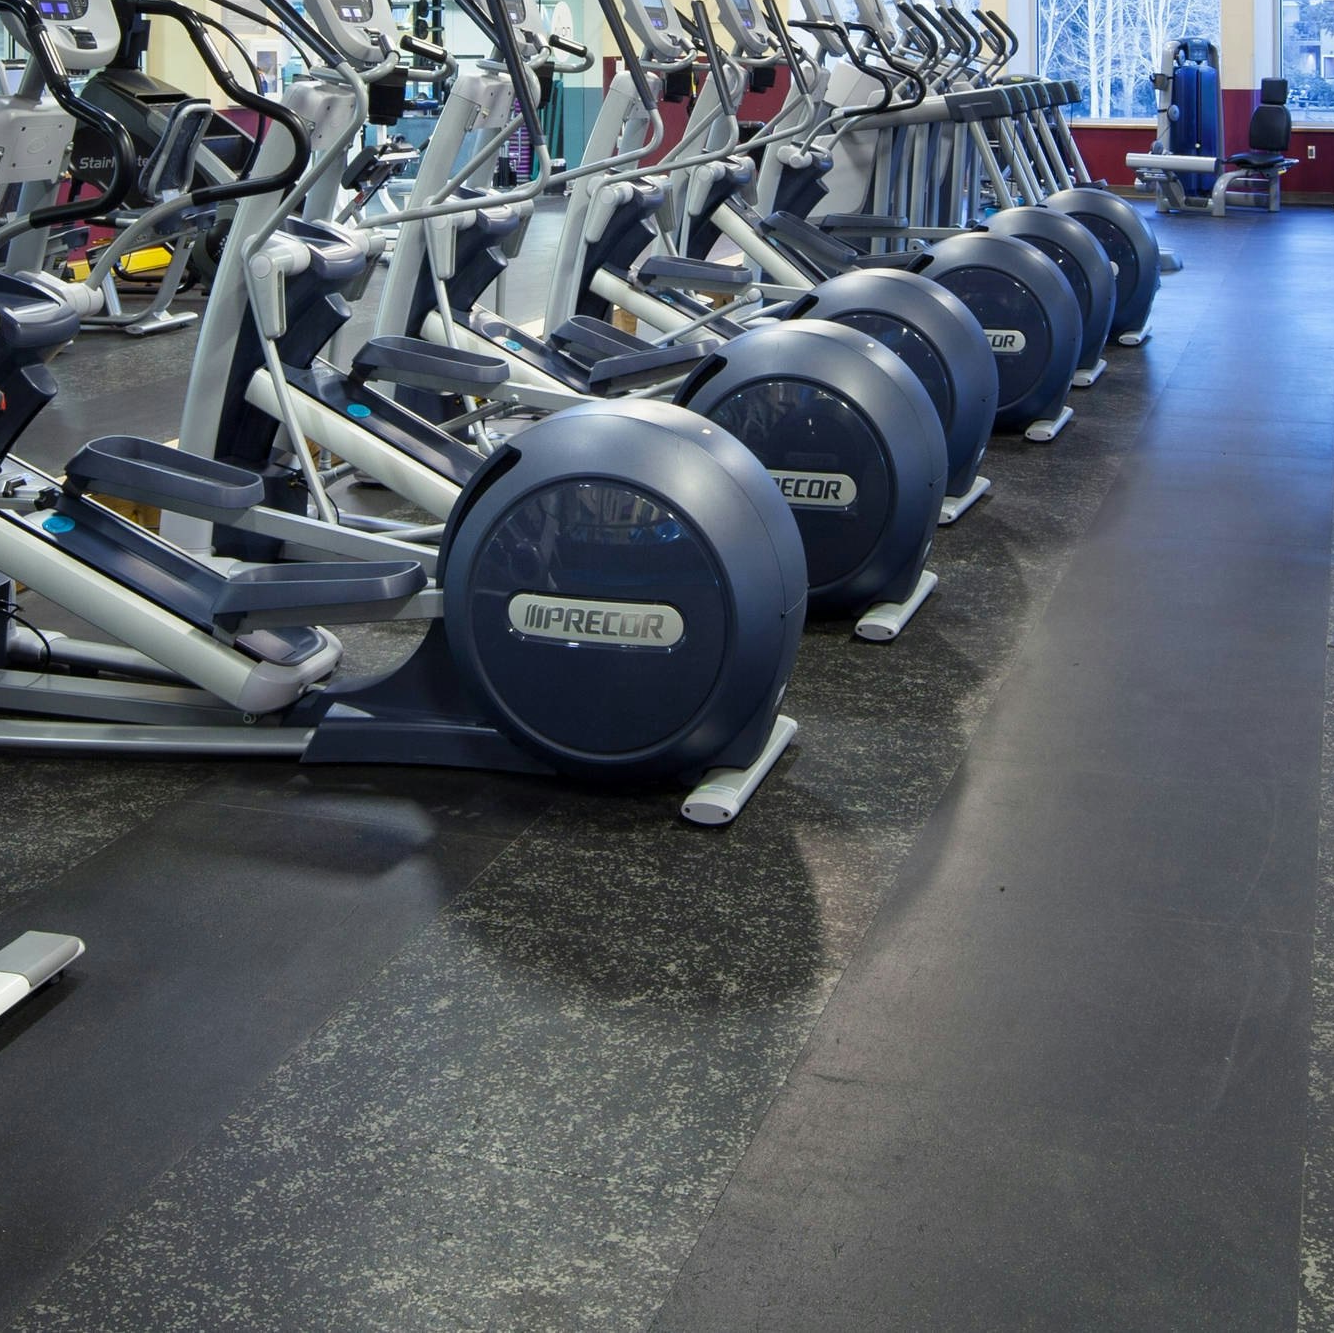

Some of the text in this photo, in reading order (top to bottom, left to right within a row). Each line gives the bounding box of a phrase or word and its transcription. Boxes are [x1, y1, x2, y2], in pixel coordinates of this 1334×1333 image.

[79, 154, 149, 169] Stairte
[772, 477, 842, 500] ECOR
[543, 606, 664, 639] PRECOR
